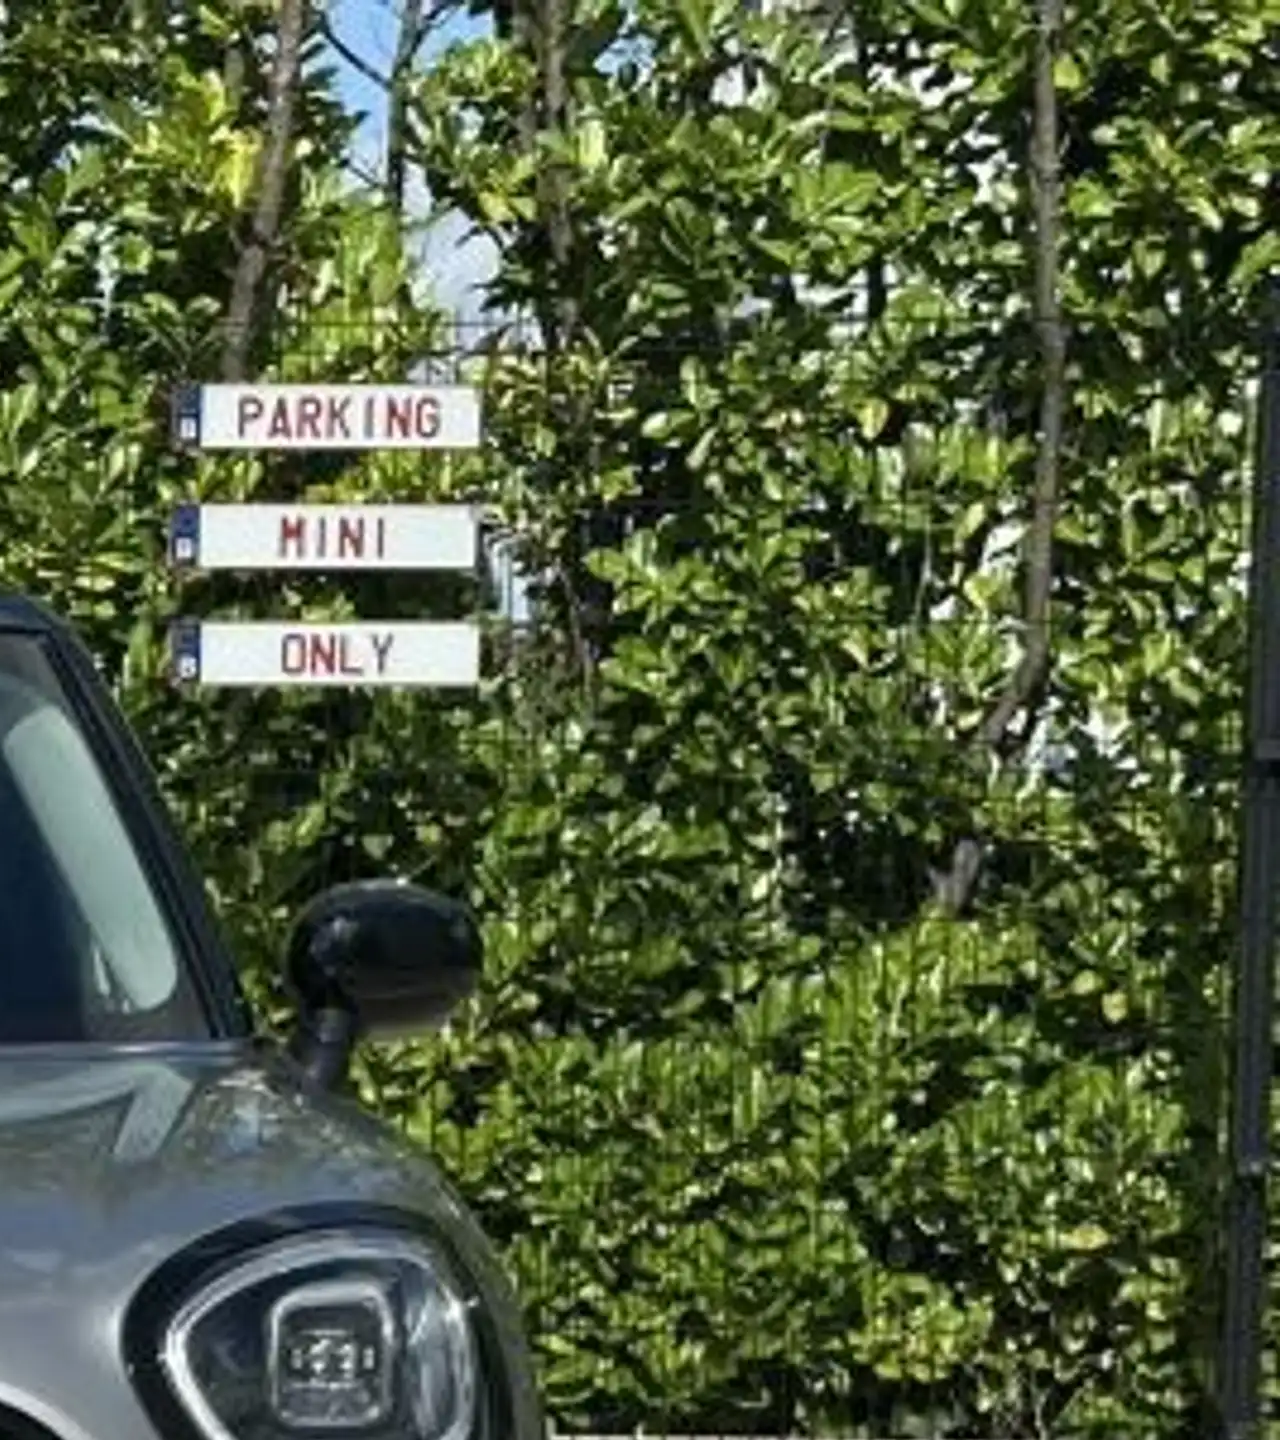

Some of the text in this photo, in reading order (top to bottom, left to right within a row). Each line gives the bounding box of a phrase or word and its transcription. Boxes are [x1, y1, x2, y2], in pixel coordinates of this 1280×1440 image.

[238, 396, 441, 439] PARKING
[278, 515, 385, 559] MINI
[280, 632, 394, 676] ONLY
